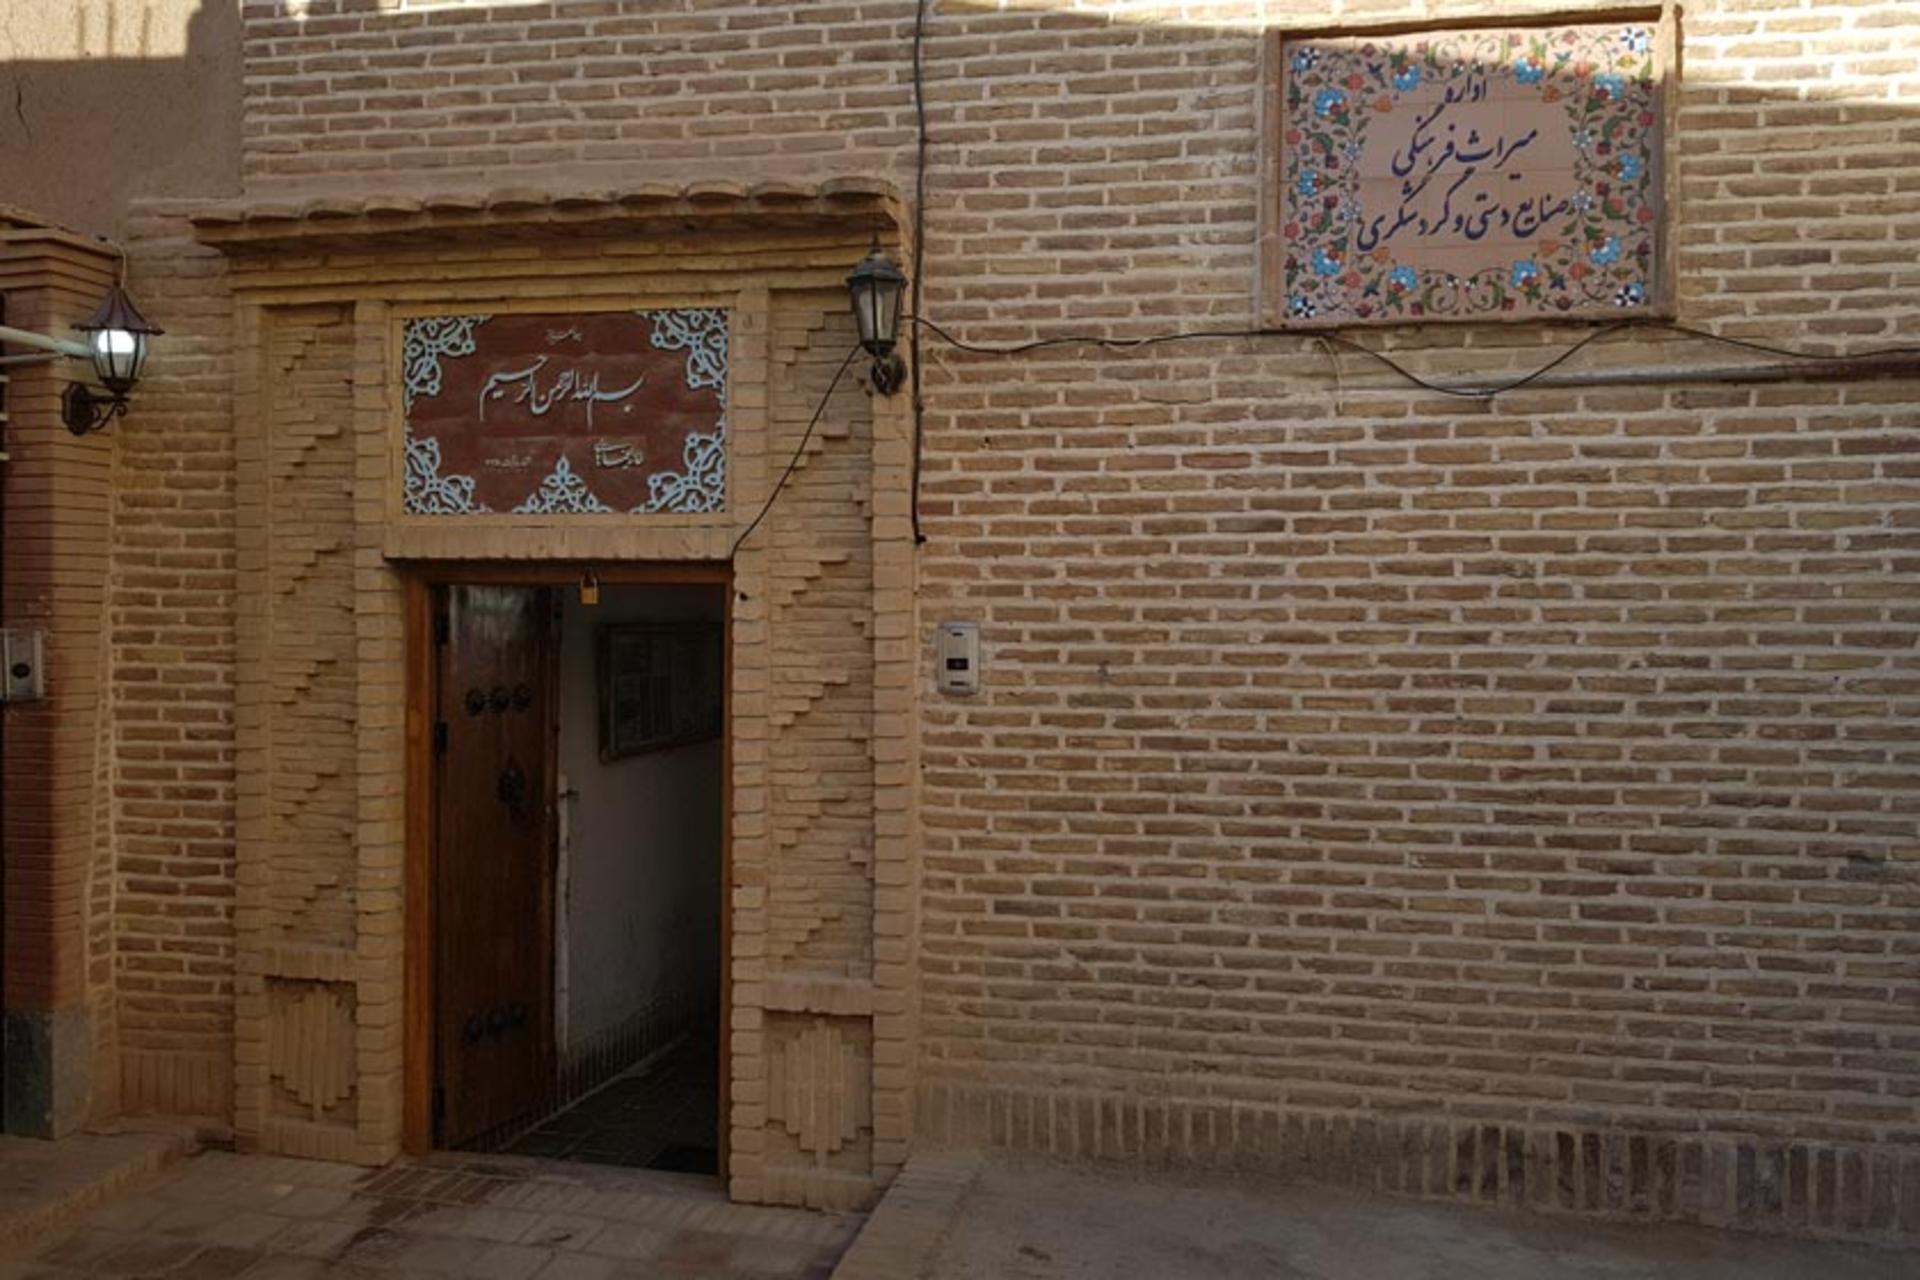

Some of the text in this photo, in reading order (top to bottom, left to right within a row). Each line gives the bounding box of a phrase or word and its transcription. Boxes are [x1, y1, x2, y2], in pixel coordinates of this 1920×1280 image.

[1445, 75, 1487, 103] اداره
[1391, 103, 1538, 180] میراث فرهنگی
[1357, 167, 1569, 250] صنایع دستی و گردشگری
